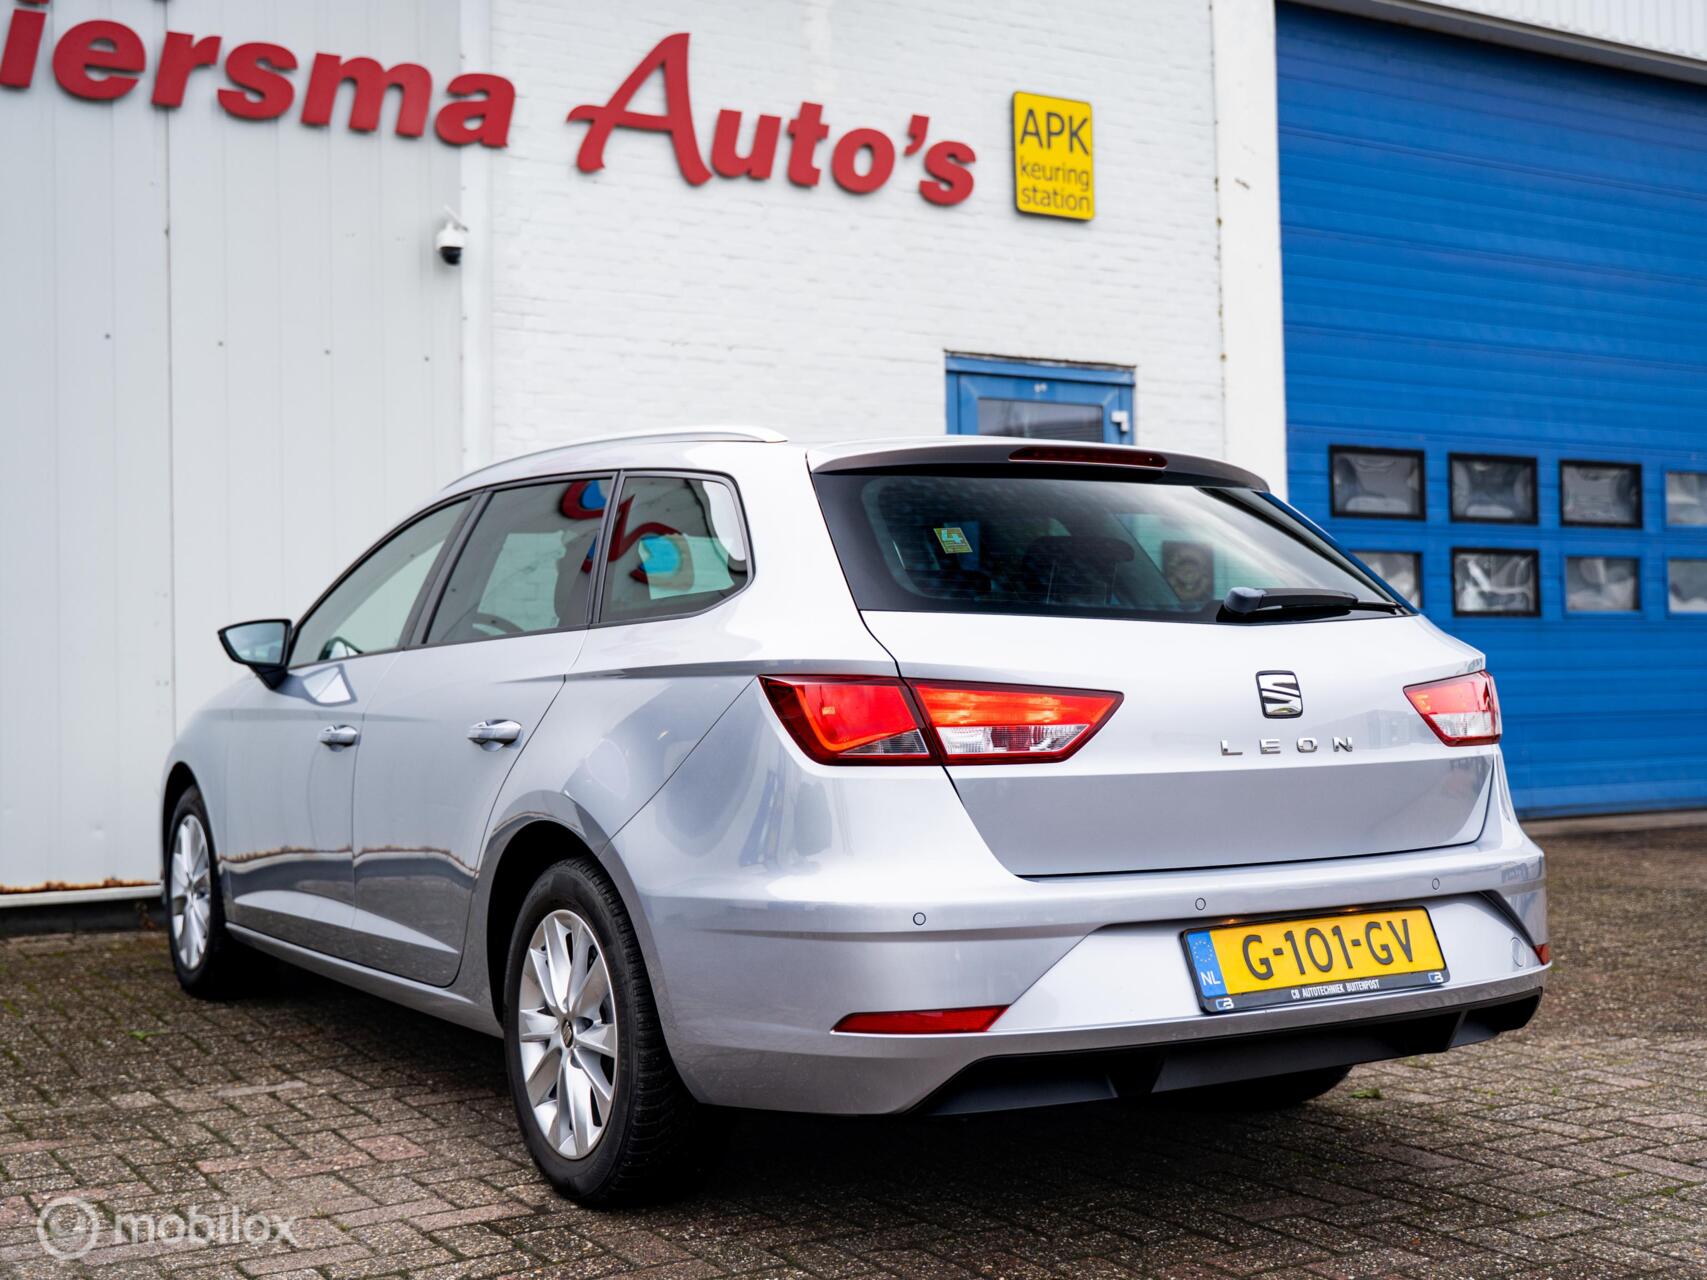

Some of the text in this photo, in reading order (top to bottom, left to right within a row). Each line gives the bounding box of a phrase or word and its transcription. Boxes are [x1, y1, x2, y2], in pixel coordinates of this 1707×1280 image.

[566, 32, 977, 207] Auto's
[1020, 108, 1089, 156] APK
[1020, 156, 1089, 192] keuring
[1021, 185, 1091, 213] station
[1220, 736, 1353, 756] LEON
[1242, 919, 1413, 980] G-101-GV
[1200, 970, 1221, 986] NL
[1302, 984, 1345, 997] AUTOTECHNIEK
